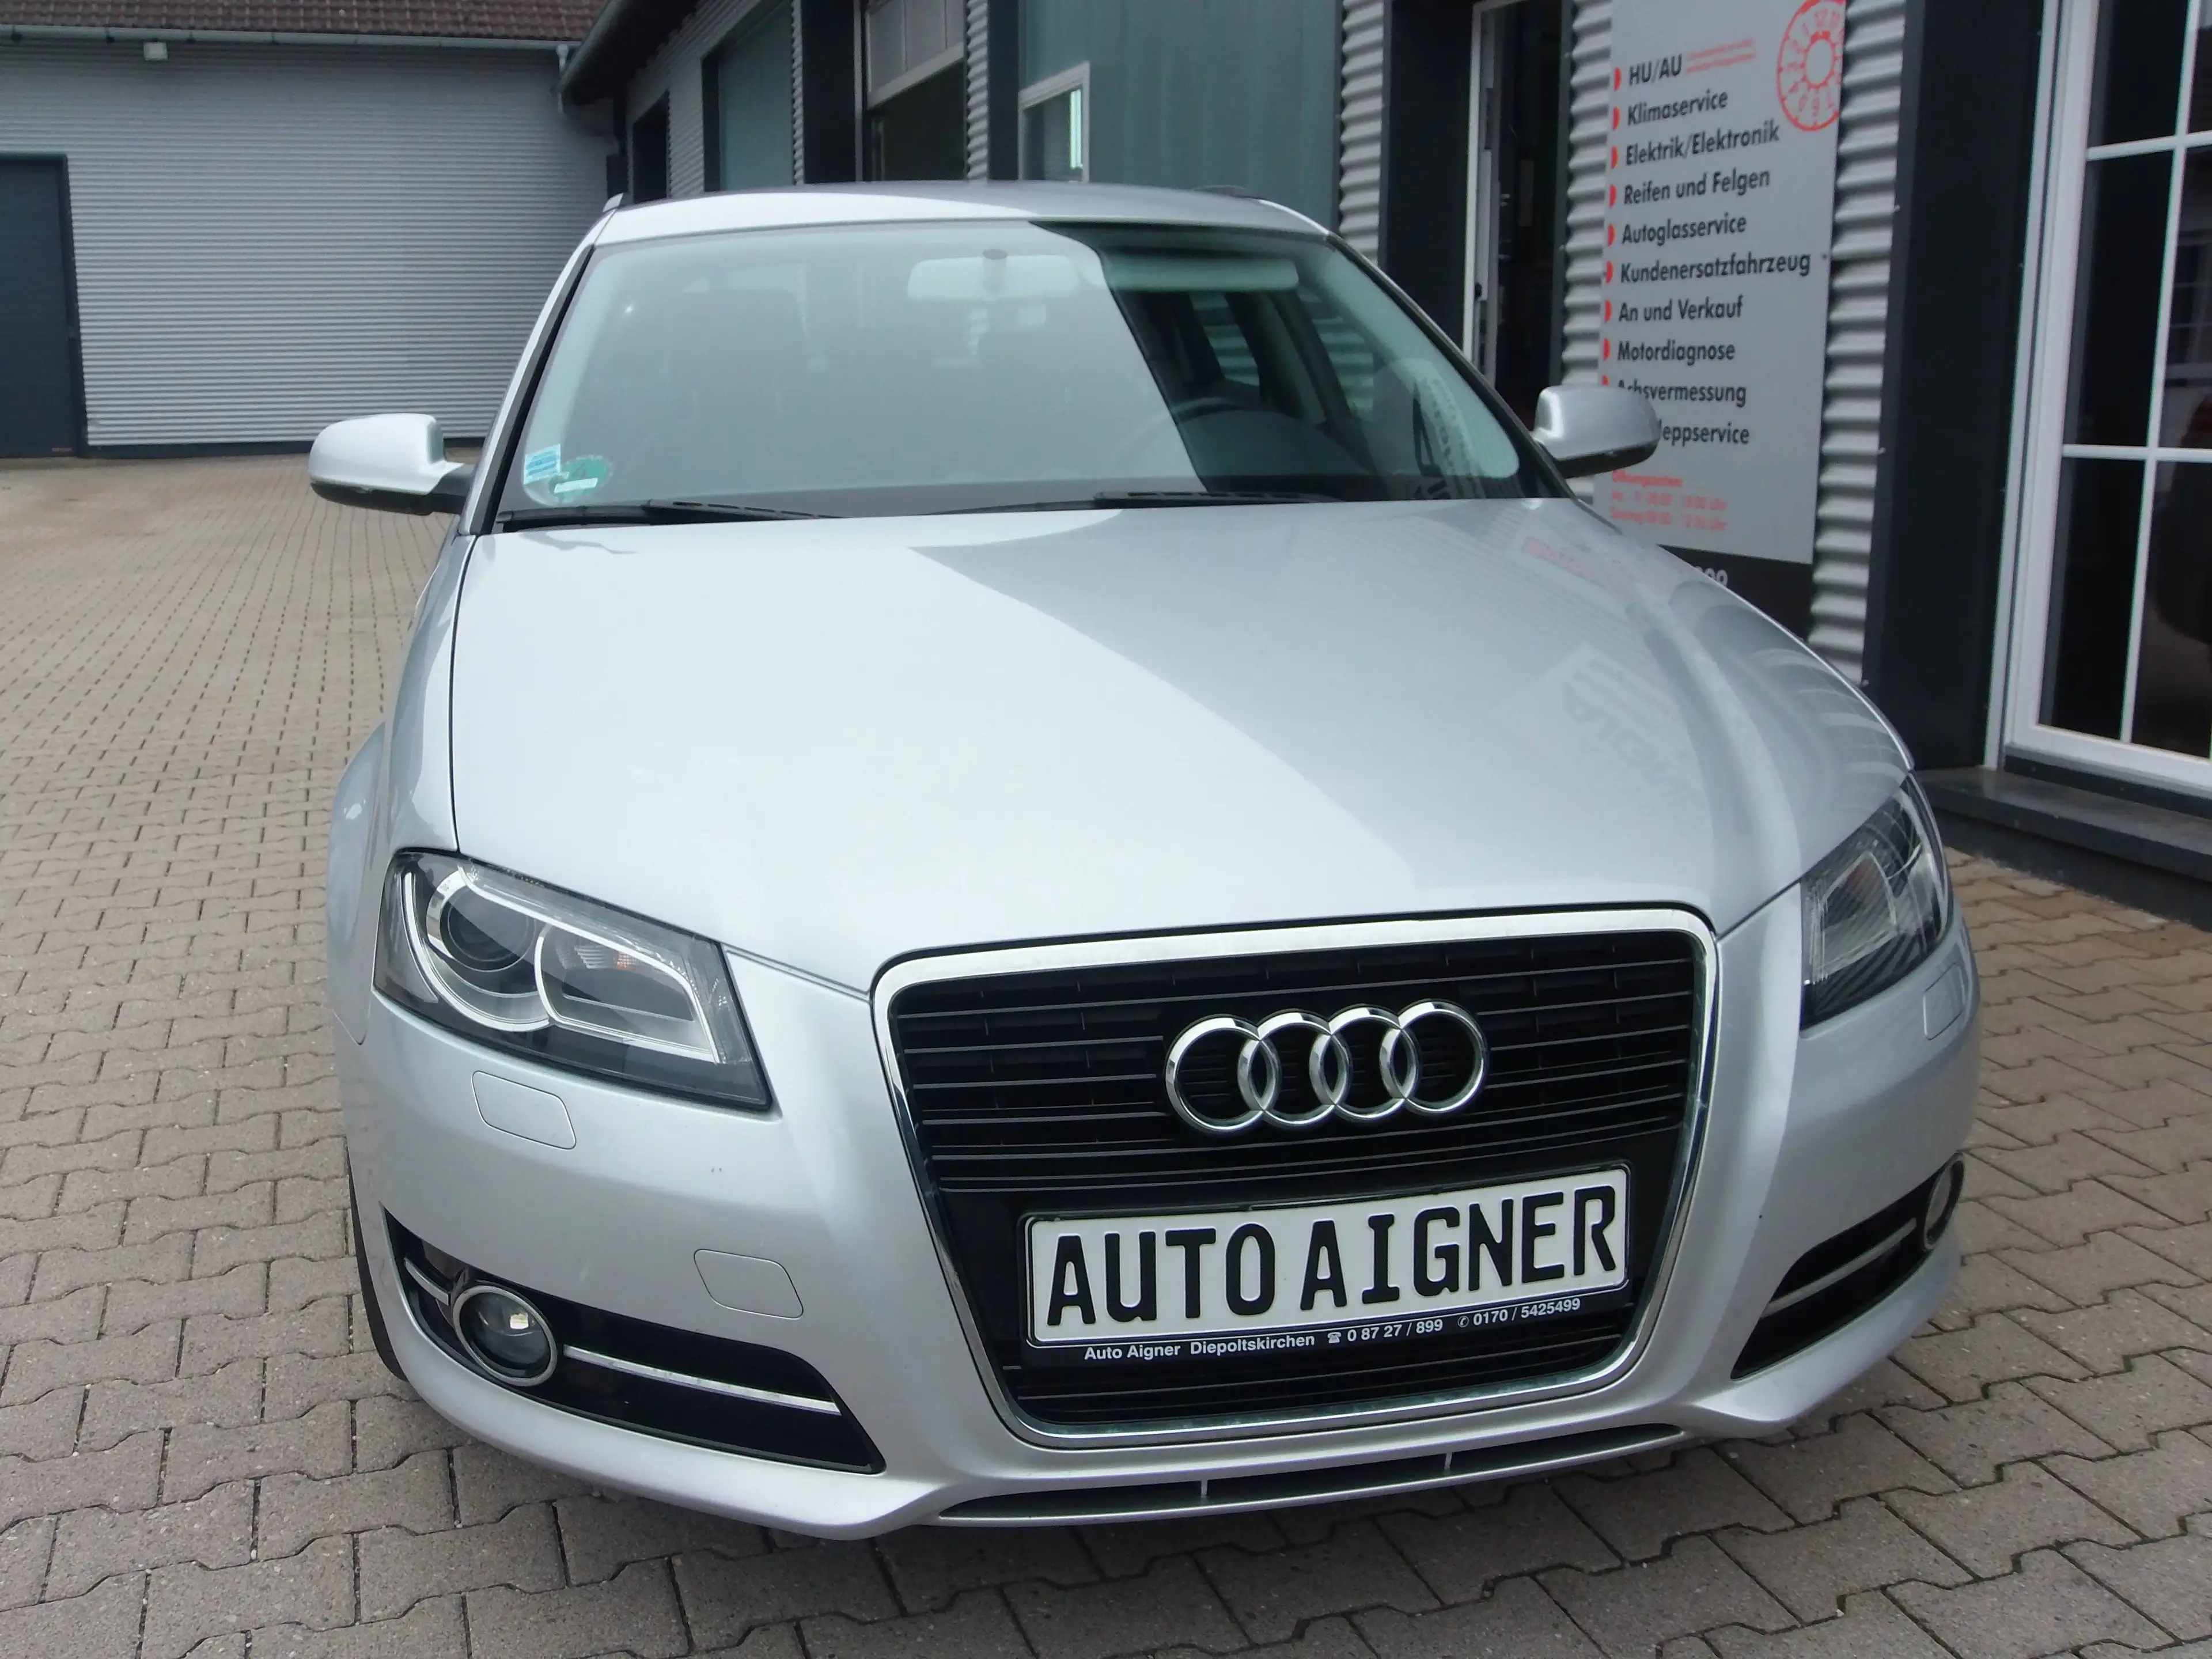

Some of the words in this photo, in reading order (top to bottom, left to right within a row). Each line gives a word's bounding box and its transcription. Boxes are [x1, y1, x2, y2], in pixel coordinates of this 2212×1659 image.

[1629, 54, 1682, 86] HU/AU
[1627, 89, 1729, 126] Klimaservice
[1626, 118, 1779, 166] Elektrik/Elektronik
[1624, 180, 1671, 205] Reifen
[1676, 173, 1707, 199] und
[1712, 168, 1770, 196] Felgen
[1622, 211, 1747, 247] Autoglasservice
[1620, 252, 1811, 283] Kundenersatzfahrzeug
[1619, 302, 1638, 321] An
[1643, 299, 1672, 321] und
[1678, 294, 1744, 320] Verkauf
[1618, 339, 1736, 366] Motordiagnose
[1046, 1223, 1277, 1327] AUTO
[1299, 1184, 1617, 1311] AIGNER
[1084, 1346, 1123, 1361] Auto
[1127, 1344, 1181, 1361] Aigner
[1190, 1335, 1315, 1357] Diepoltskirchen
[1415, 1318, 1444, 1334] 899
[1472, 1308, 1509, 1326] 0170
[1520, 1297, 1581, 1319] 5425499
